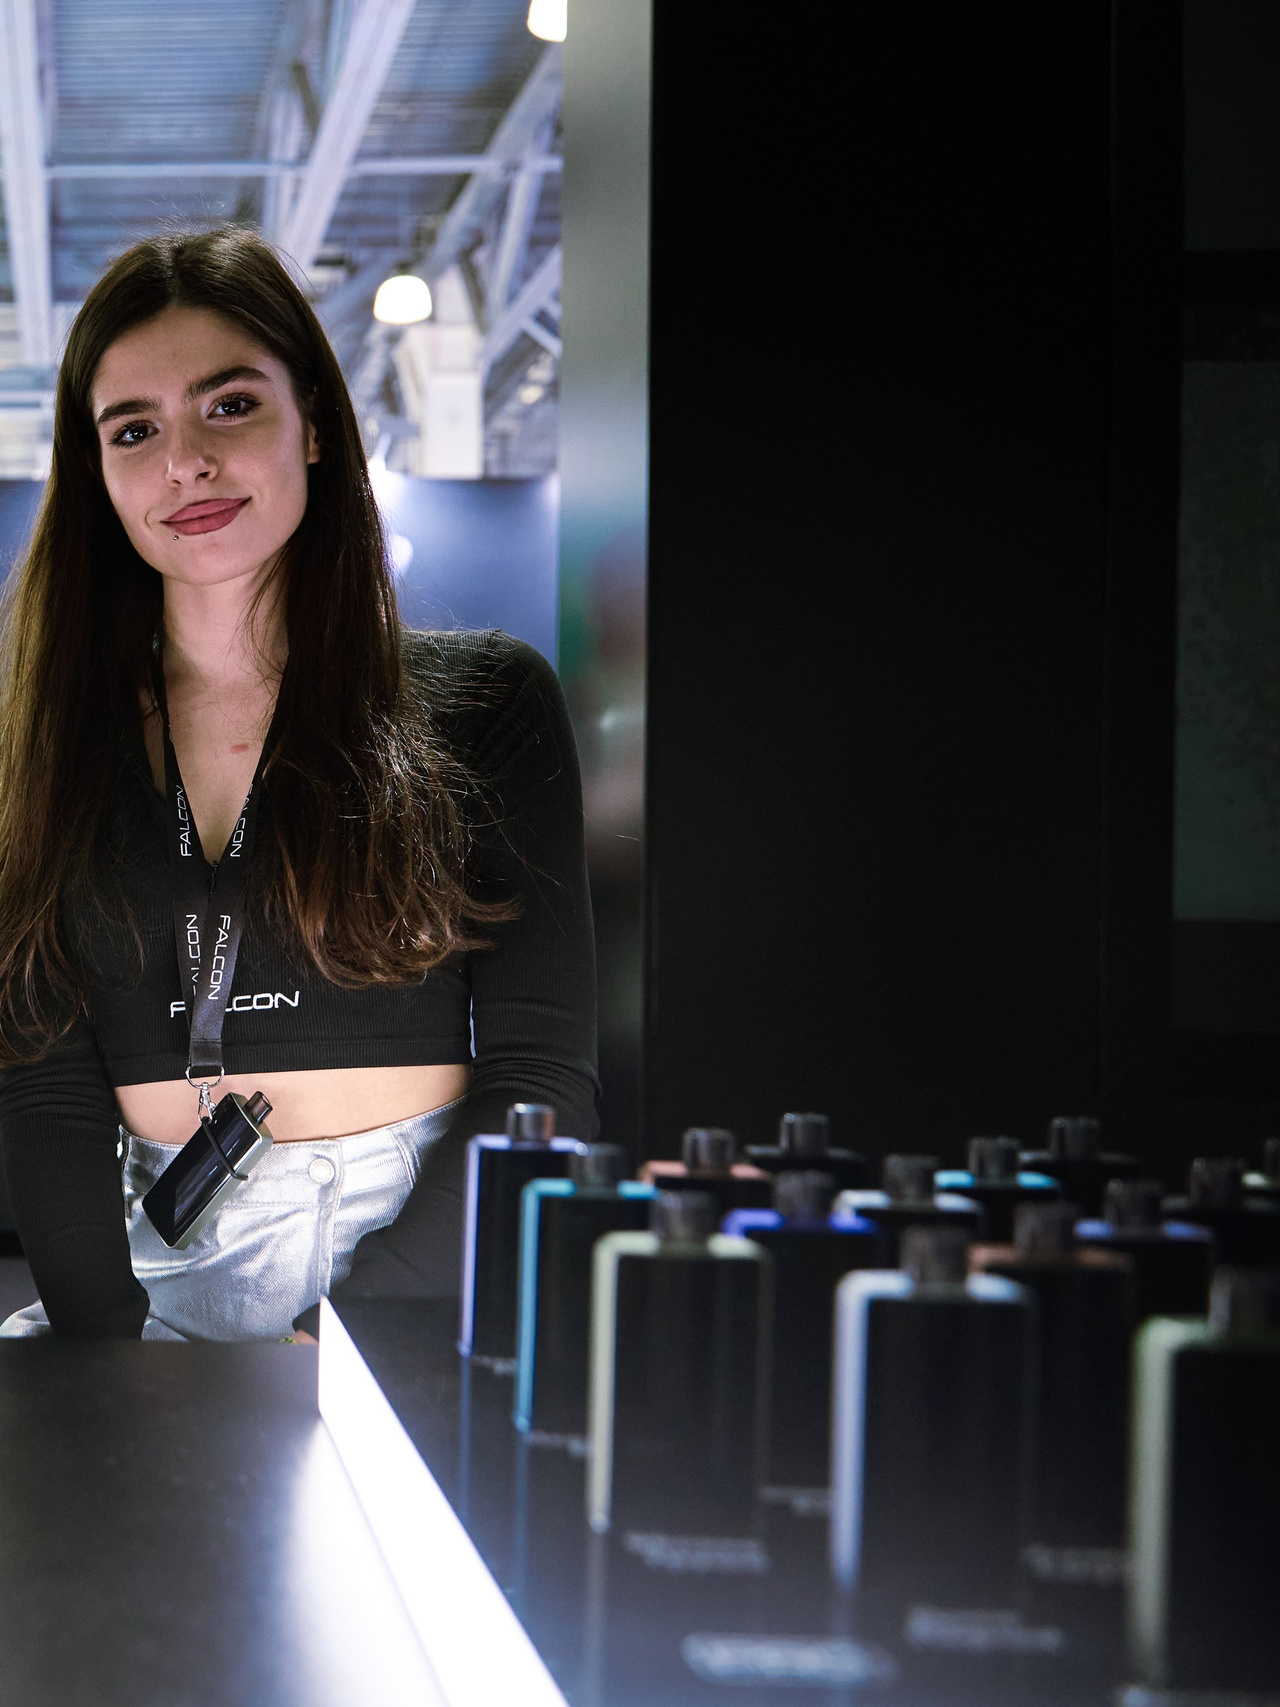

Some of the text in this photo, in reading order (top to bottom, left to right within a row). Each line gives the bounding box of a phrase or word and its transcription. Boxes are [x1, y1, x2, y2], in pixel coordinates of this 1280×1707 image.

[175, 785, 192, 857] FALCON
[207, 914, 231, 1000] FALCON
[170, 990, 300, 1018] FCON
